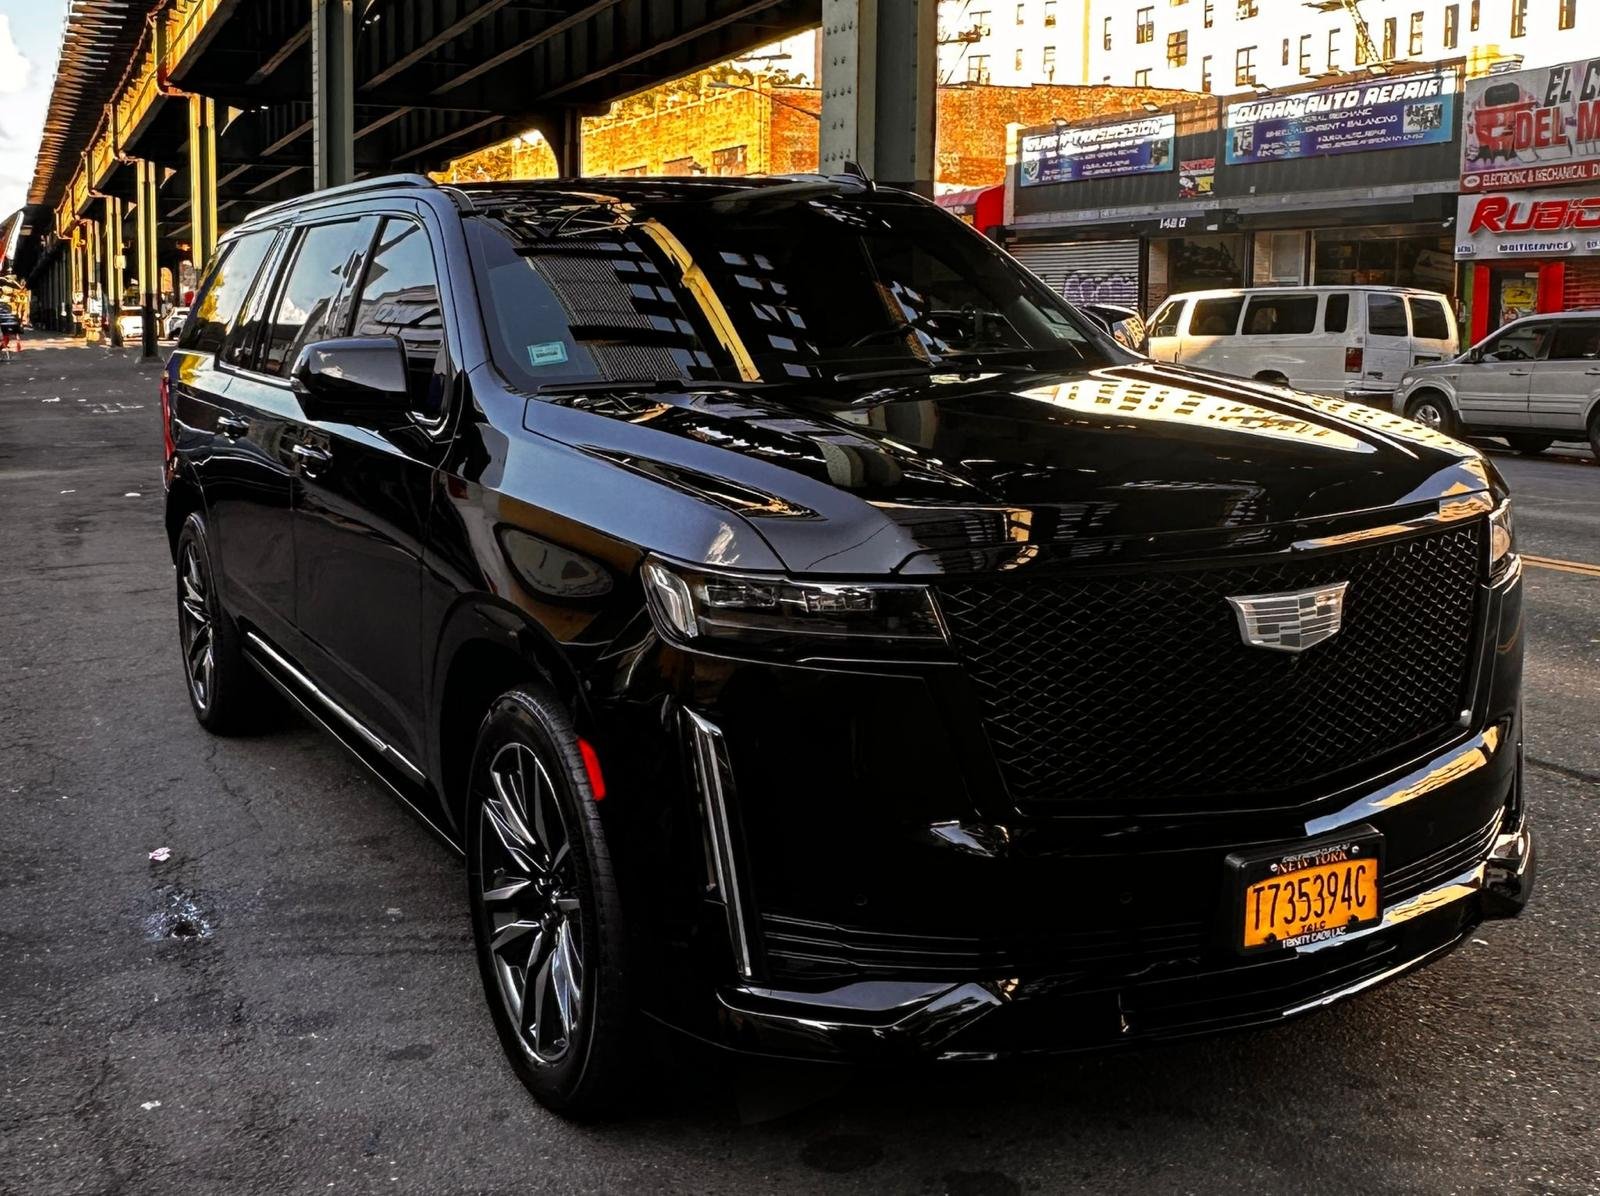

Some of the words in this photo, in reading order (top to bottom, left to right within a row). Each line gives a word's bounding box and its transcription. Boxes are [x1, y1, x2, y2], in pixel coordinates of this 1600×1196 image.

[1305, 90, 1362, 115] AUTO
[1364, 77, 1442, 103] REPAIR
[1544, 66, 1571, 107] EL
[1515, 106, 1567, 151] DEL
[1483, 171, 1527, 186] ELECTRONIC
[1535, 165, 1587, 181] MECHANICAL
[1277, 856, 1310, 874] NEW
[1315, 849, 1348, 866] YORK
[1253, 865, 1366, 930] T735394C
